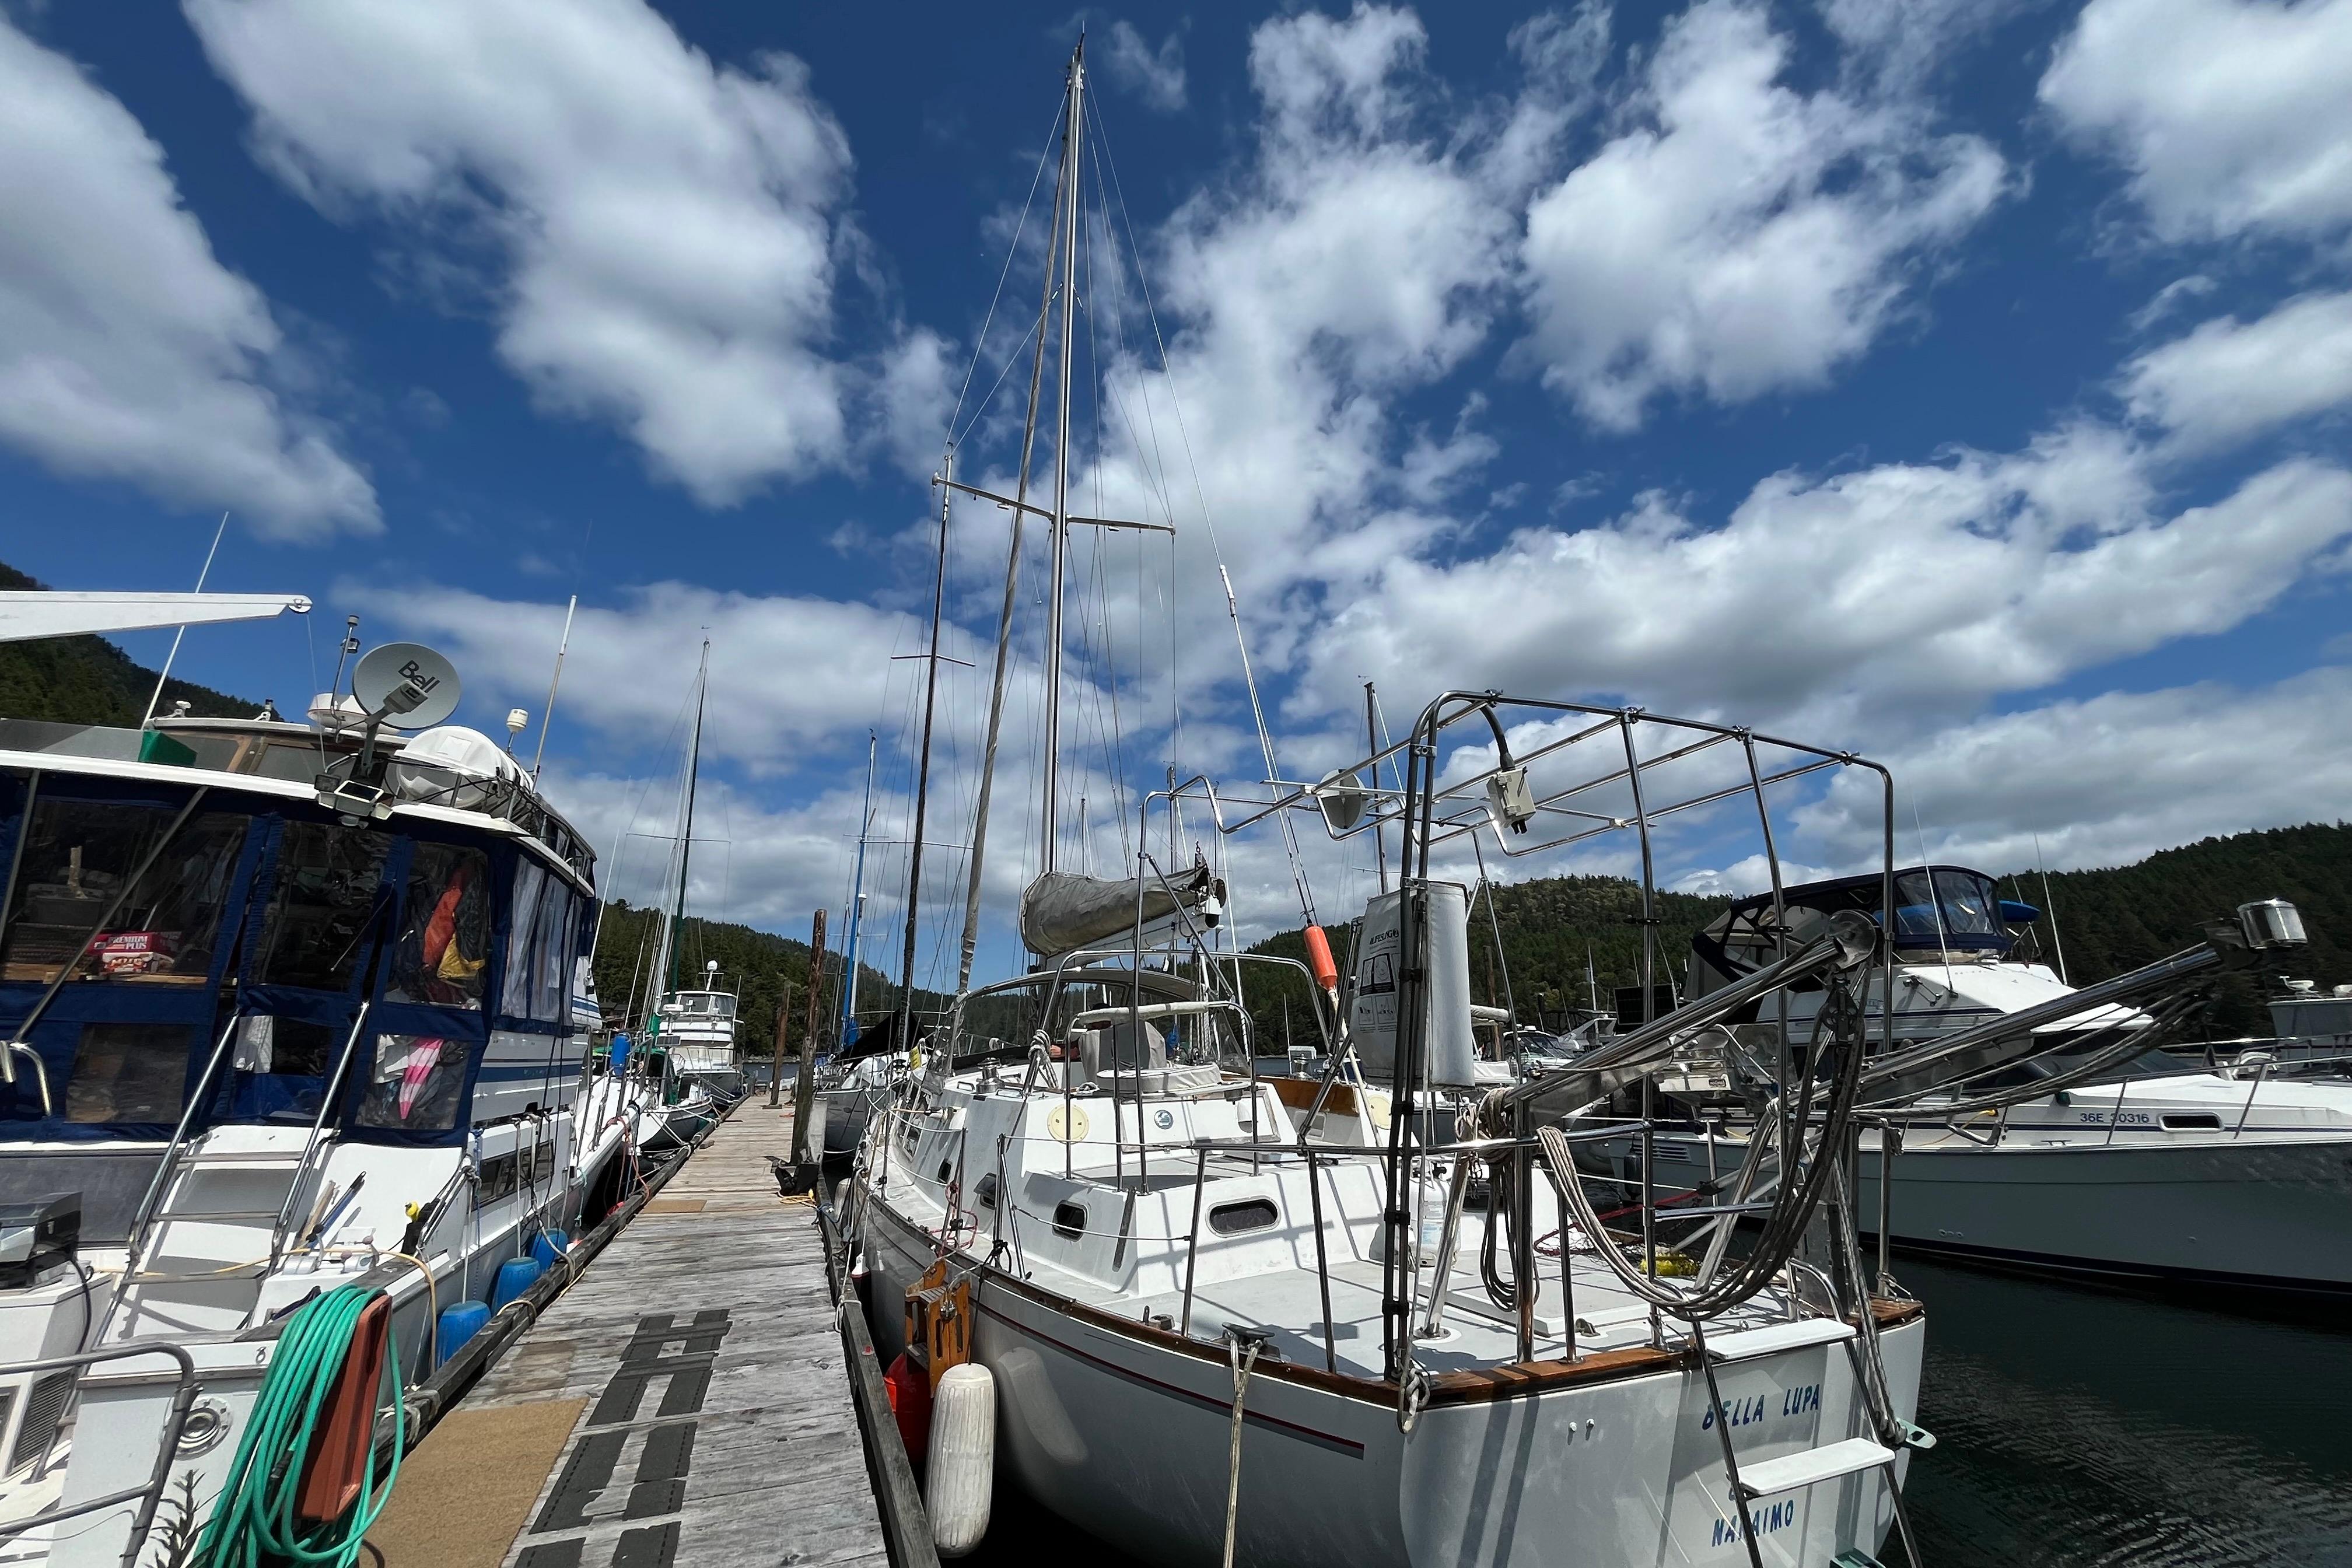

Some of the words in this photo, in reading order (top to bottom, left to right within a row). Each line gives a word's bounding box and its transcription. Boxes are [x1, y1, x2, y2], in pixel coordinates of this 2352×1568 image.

[398, 660, 440, 693] Bell
[108, 936, 148, 944] PREMIUM
[2080, 1113, 2104, 1122] 36E
[1783, 1384, 1819, 1416] LUPA
